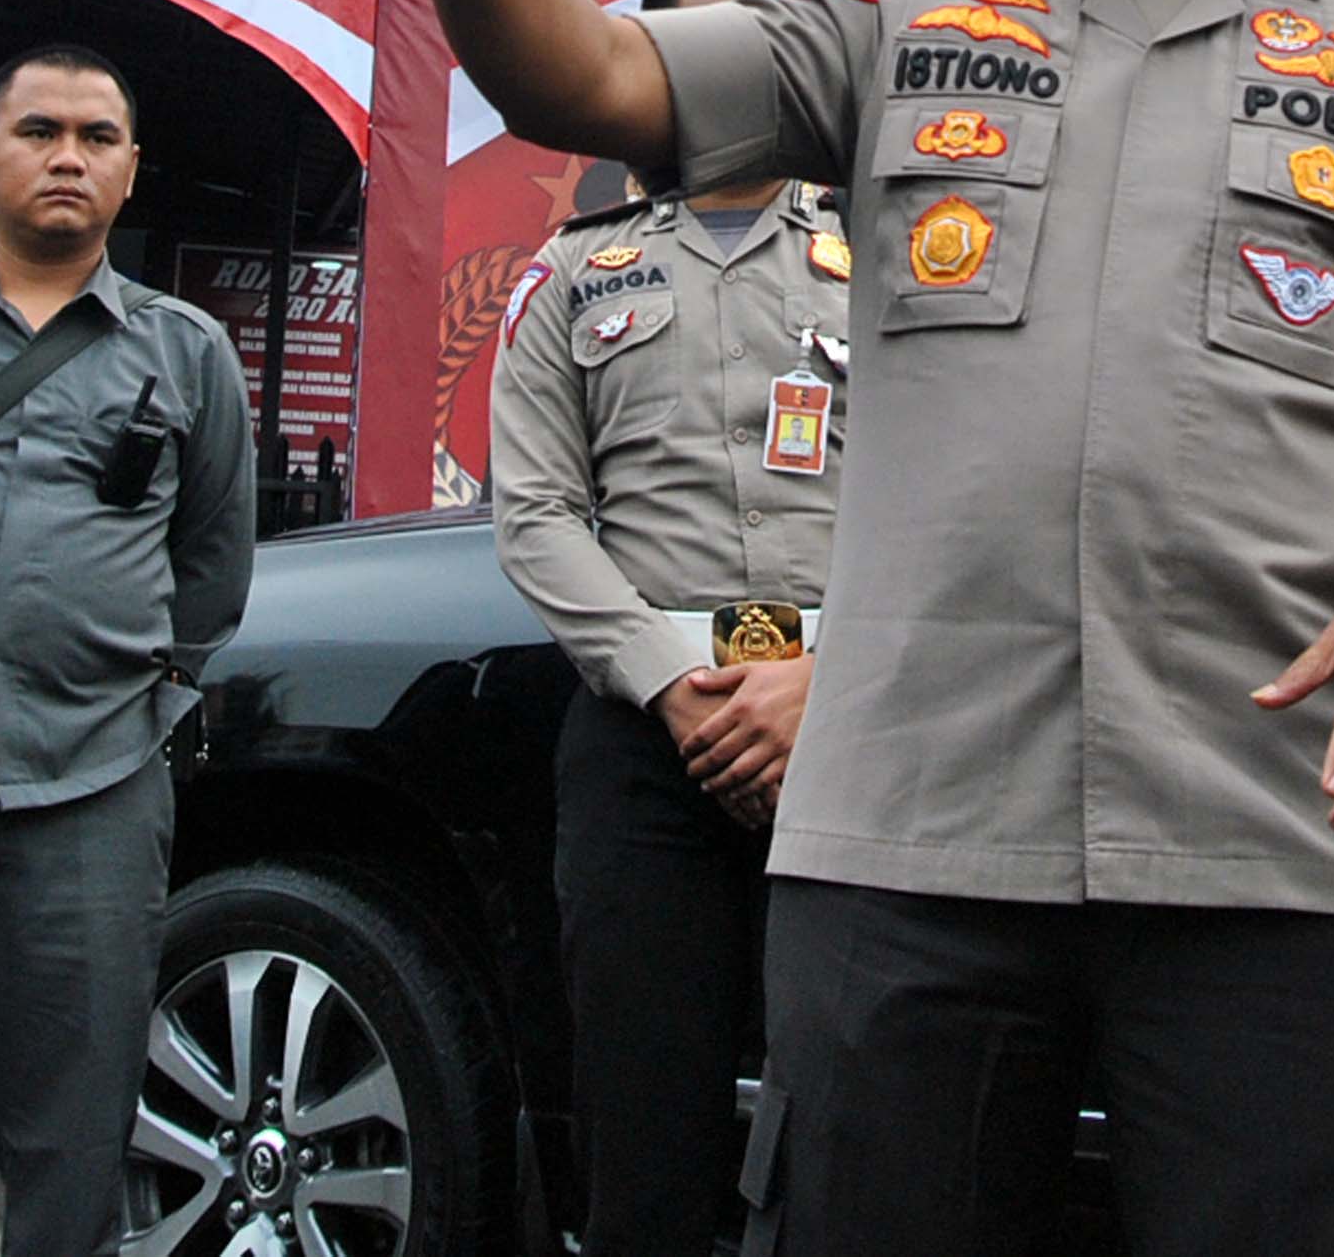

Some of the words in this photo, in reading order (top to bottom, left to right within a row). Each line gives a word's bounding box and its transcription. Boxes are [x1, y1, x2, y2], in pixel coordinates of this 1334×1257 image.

[894, 46, 1060, 99] ISTIONO
[310, 264, 358, 297] SA
[570, 267, 666, 311] ANGGA
